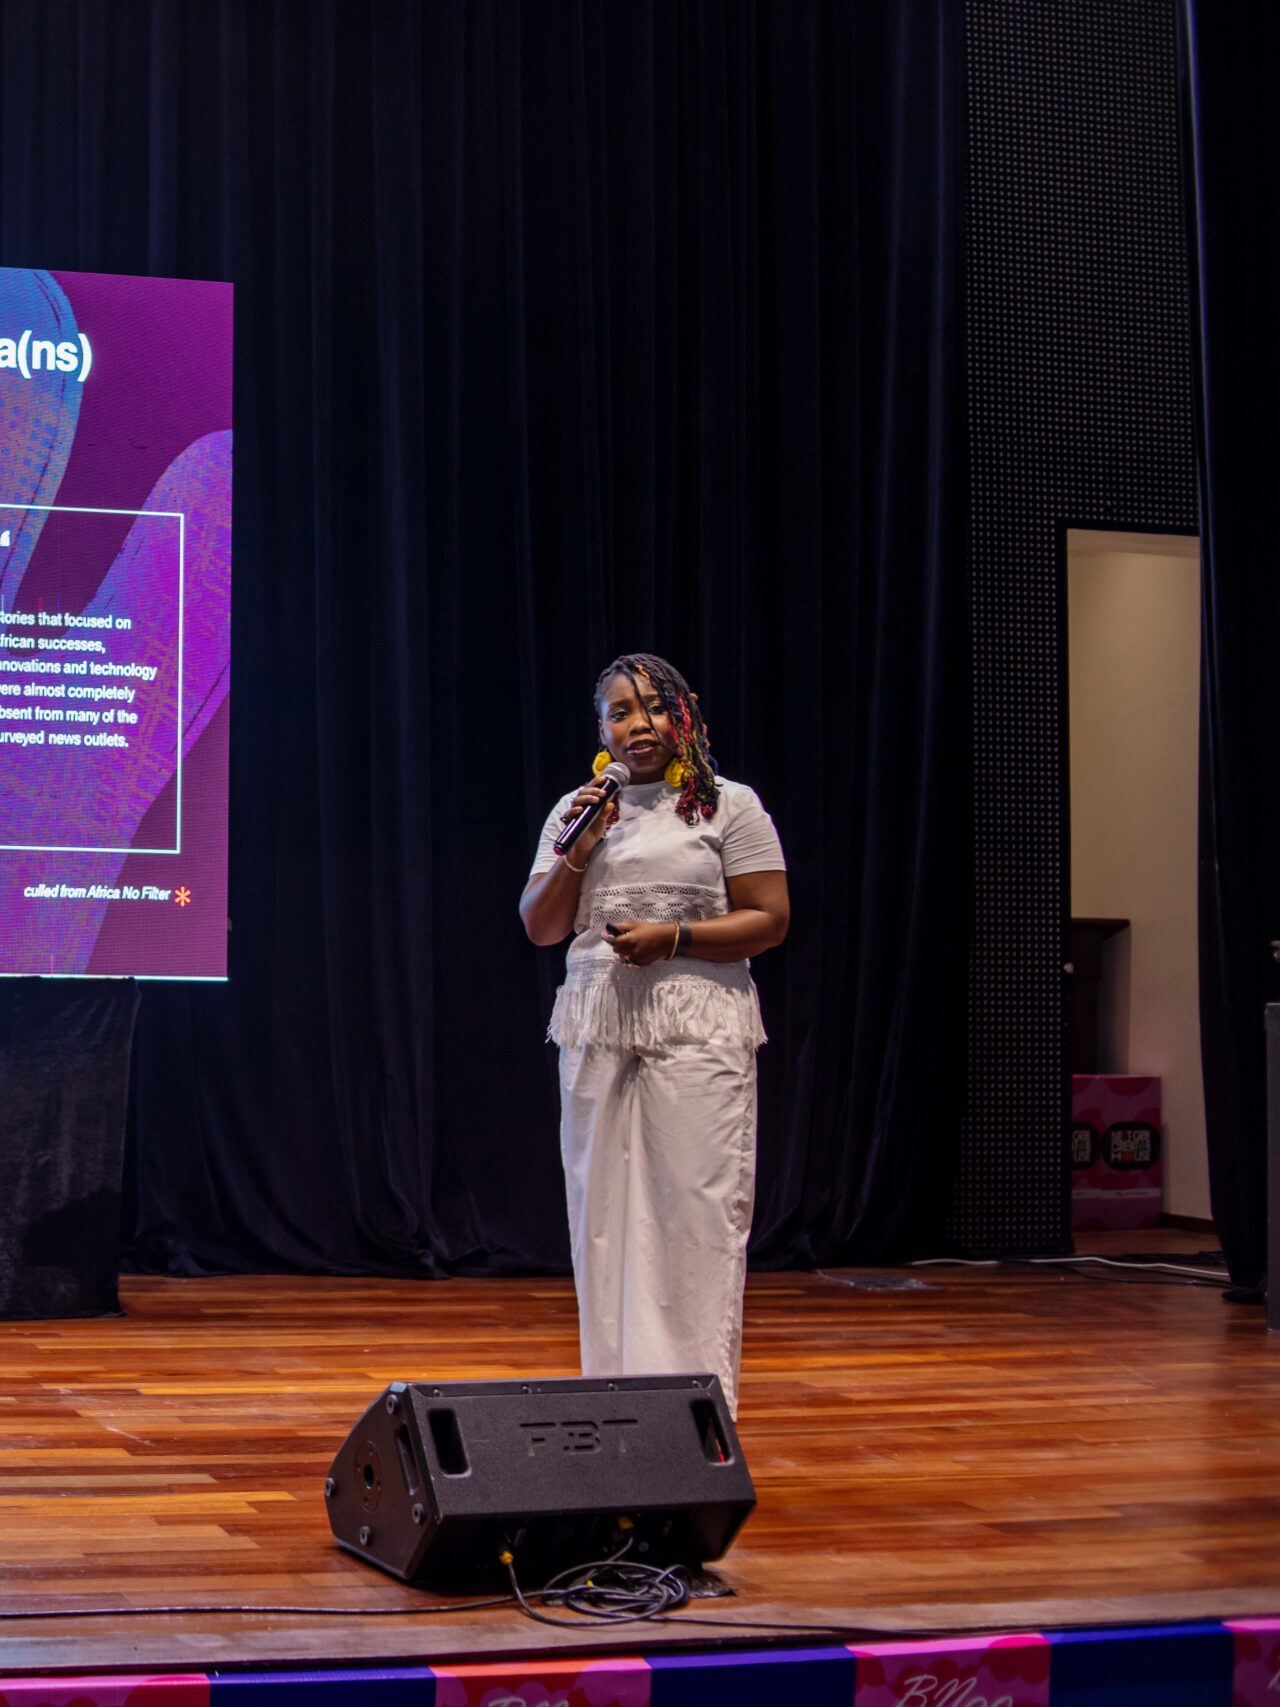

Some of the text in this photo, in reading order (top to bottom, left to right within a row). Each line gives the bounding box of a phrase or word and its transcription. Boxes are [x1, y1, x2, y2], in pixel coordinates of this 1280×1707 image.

[38, 611, 62, 626] that
[64, 612, 112, 629] focused
[115, 617, 131, 629] on
[38, 638, 106, 654] successes,
[63, 661, 87, 675] and
[90, 662, 157, 681] technology
[23, 682, 65, 697] almost
[67, 685, 135, 703] completely
[35, 706, 64, 721] from
[66, 711, 100, 725] many
[102, 709, 114, 723] of
[117, 710, 138, 724] the
[48, 733, 82, 746] news
[83, 733, 129, 748] outlets.
[24, 883, 171, 901] culled from Africa No Filter
[519, 1419, 638, 1457] FBT
